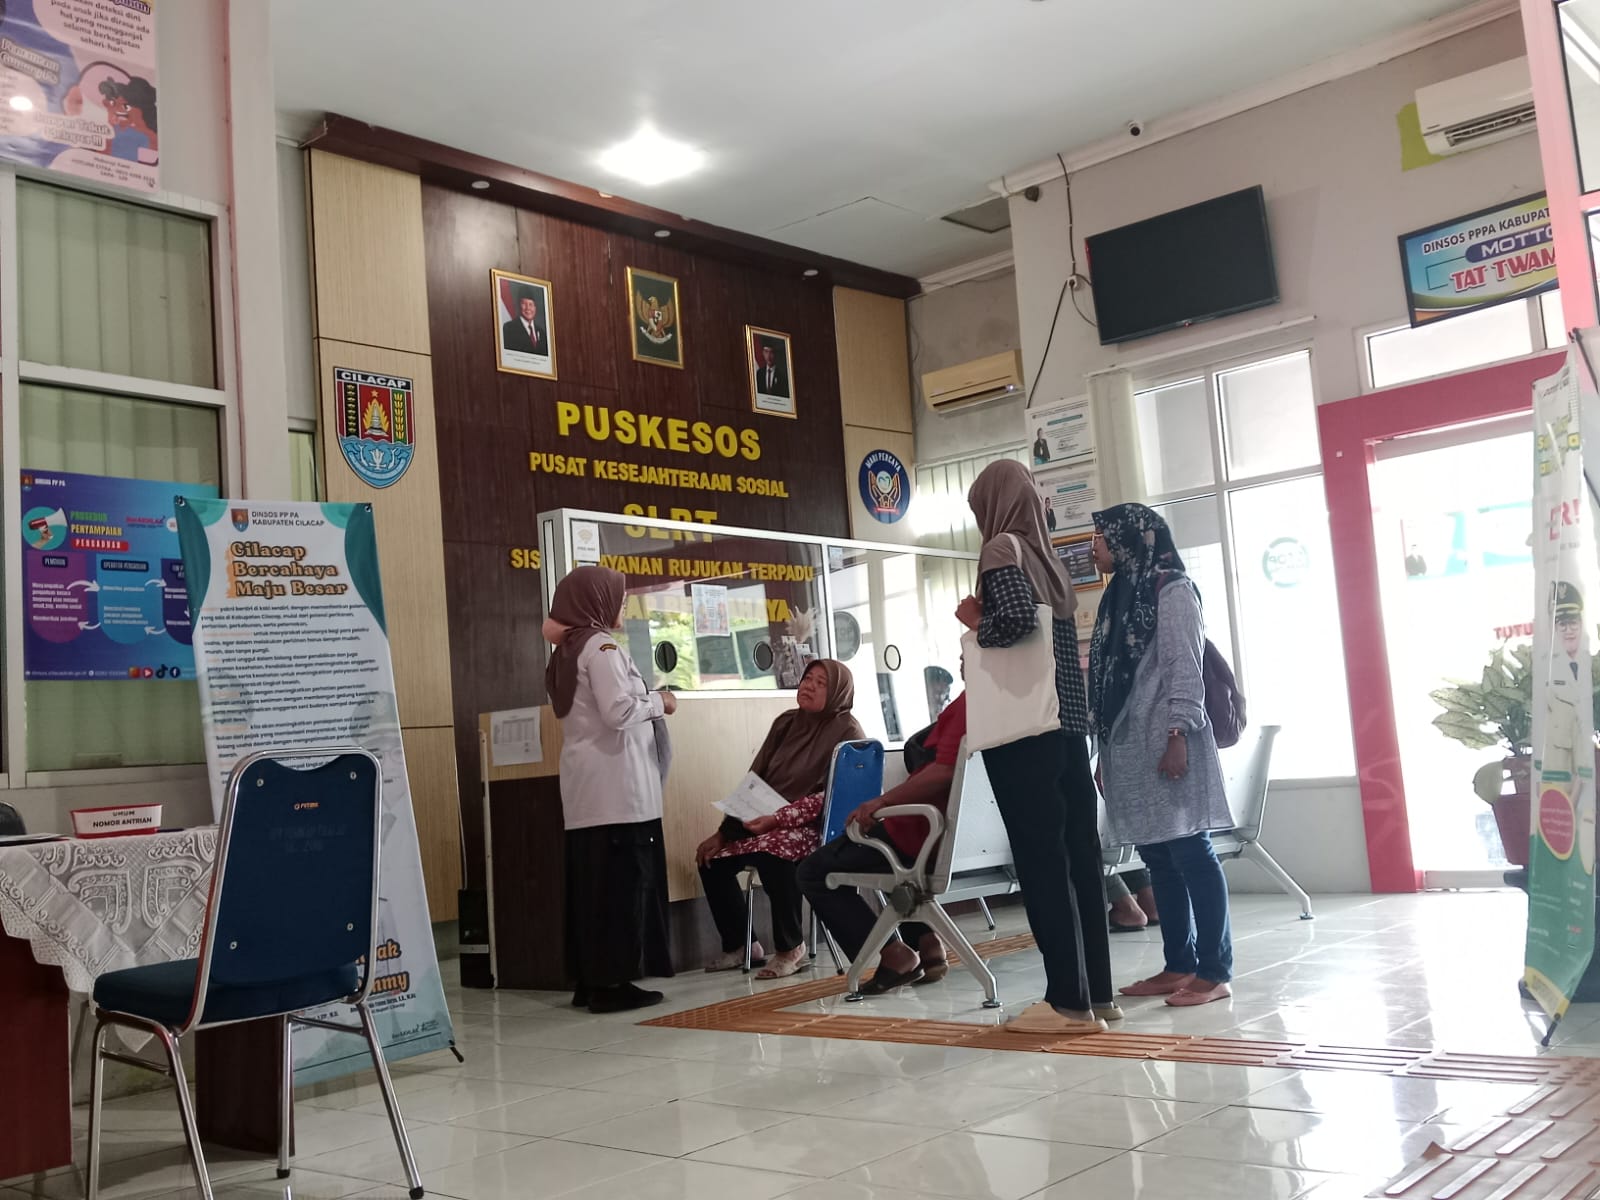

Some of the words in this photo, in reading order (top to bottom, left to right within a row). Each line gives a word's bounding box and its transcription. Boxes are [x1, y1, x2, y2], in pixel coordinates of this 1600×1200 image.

[1424, 234, 1465, 254] DINSOS
[1468, 223, 1496, 241] PPPA
[1499, 207, 1550, 232] KABUPAT
[1452, 266, 1486, 292] TAT
[341, 372, 406, 388] CILACAP
[556, 400, 761, 462] PUSKESOS
[529, 452, 586, 478] PUSAT
[593, 460, 732, 492] KESEJAHTERAAN
[736, 477, 789, 498] SOSIAL
[71, 524, 122, 536] PENYAMPAIAN
[230, 542, 306, 561] Cilacap
[233, 561, 338, 580] Bercahaya
[600, 554, 664, 576] AYANAN
[669, 558, 742, 578] RUJUKAN
[750, 563, 814, 582] TERPADU
[236, 580, 286, 600] Maju
[291, 580, 348, 596] Besar
[1494, 624, 1534, 640] TUTU
